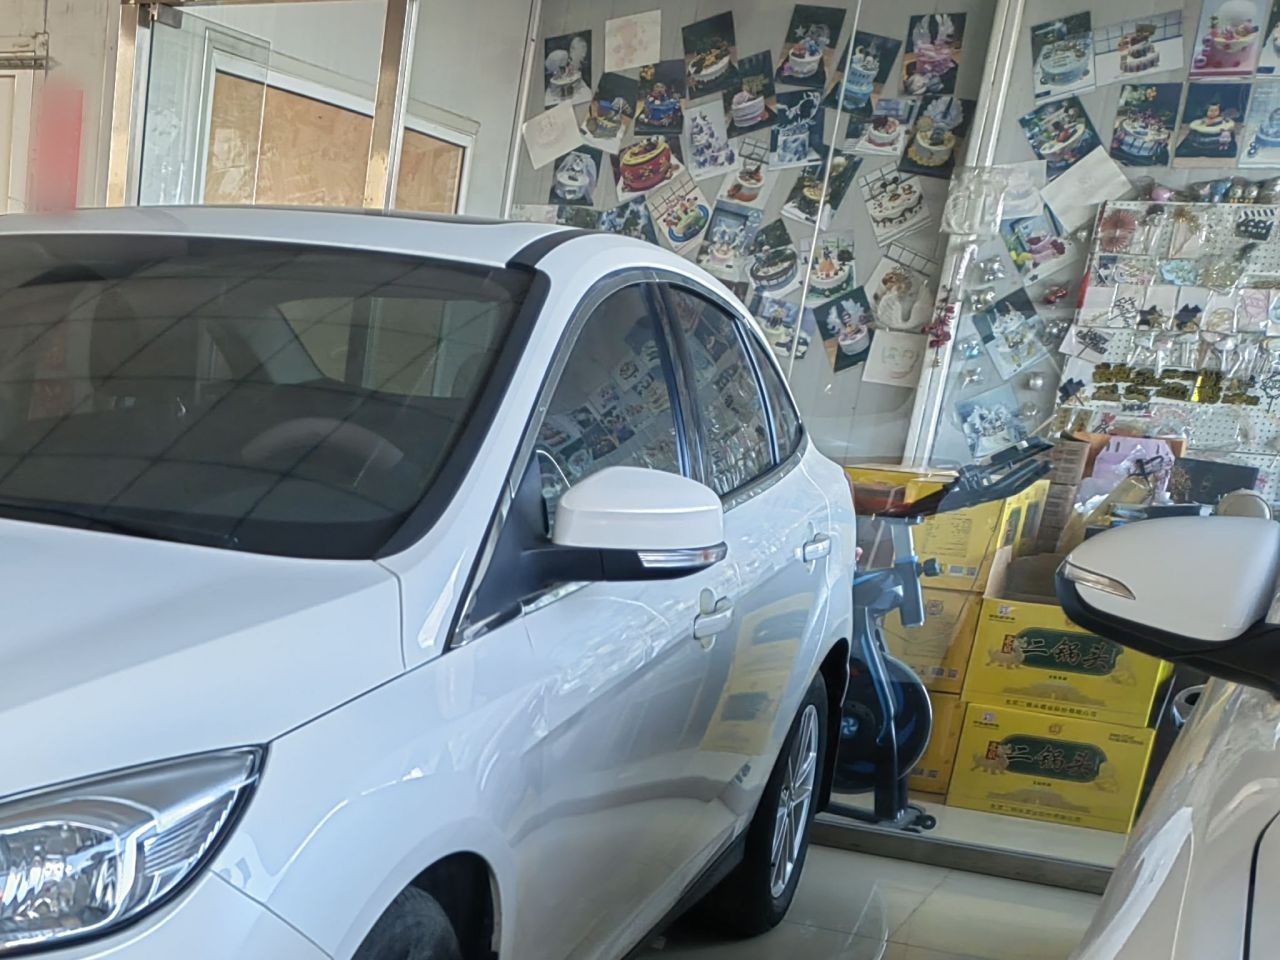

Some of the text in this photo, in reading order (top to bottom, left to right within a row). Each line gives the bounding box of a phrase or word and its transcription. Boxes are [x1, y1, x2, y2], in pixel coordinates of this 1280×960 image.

[1021, 637, 1110, 671] 二锅头
[1006, 744, 1094, 777] 二锅头
